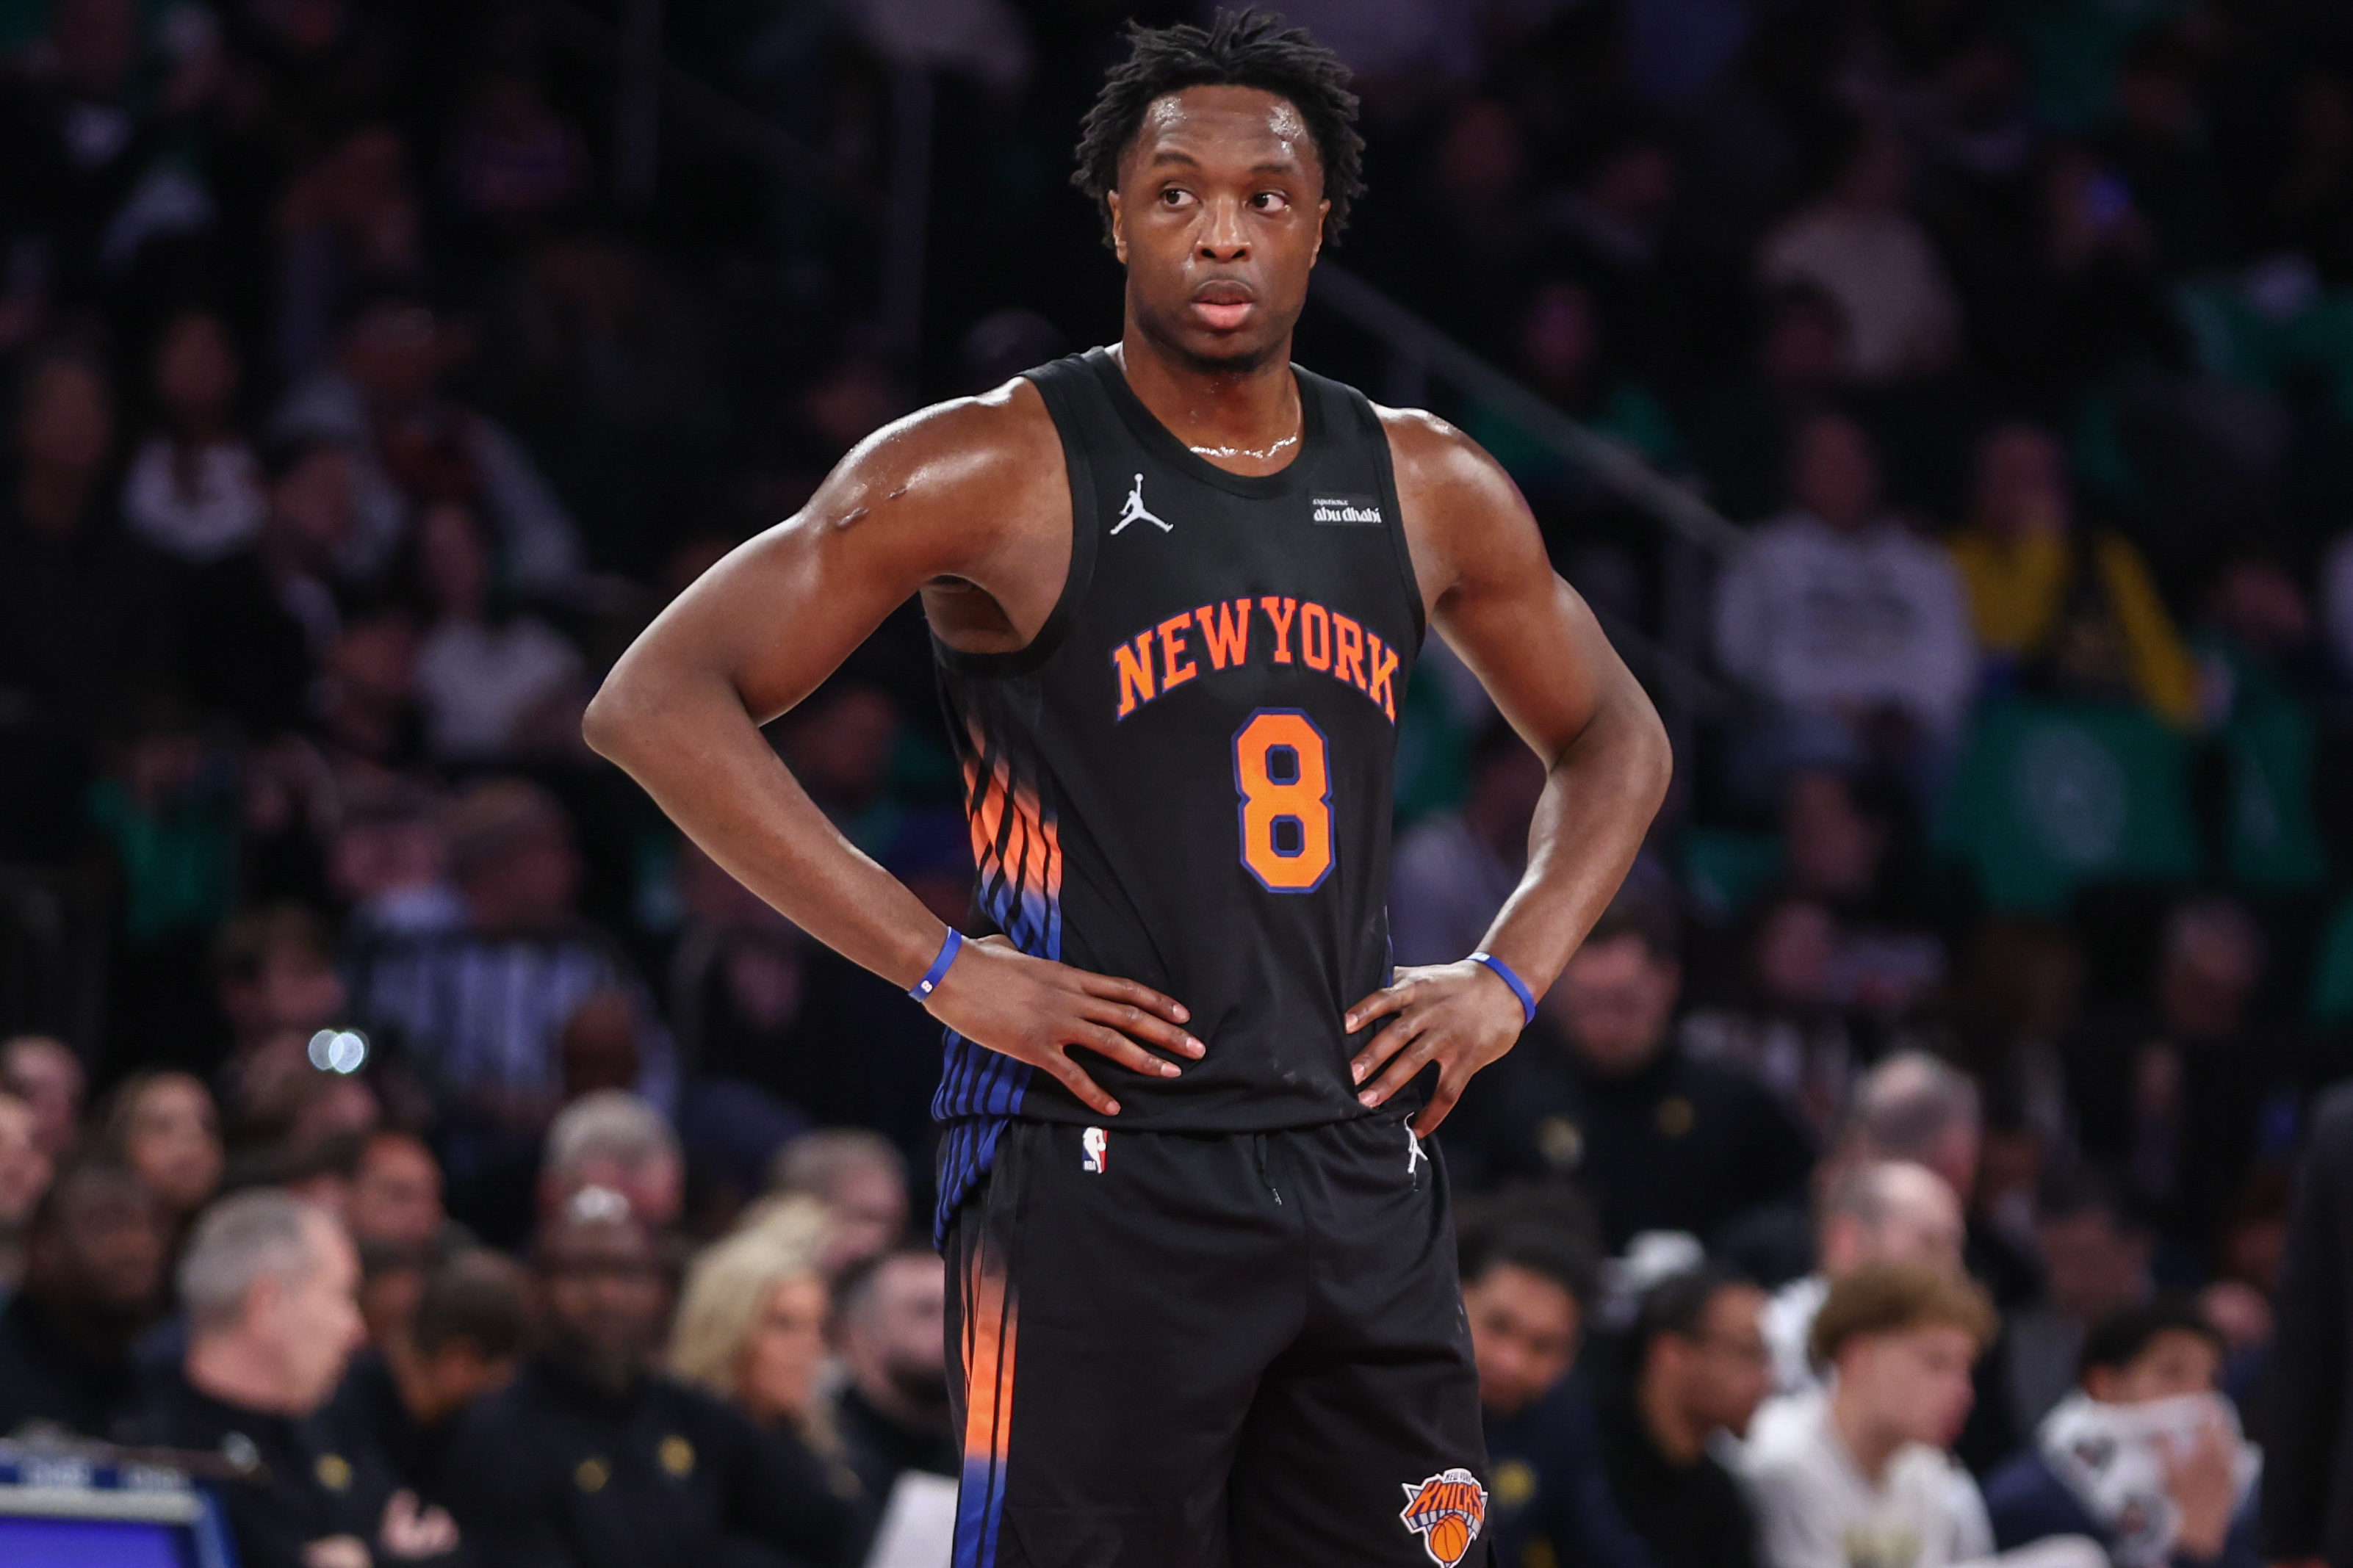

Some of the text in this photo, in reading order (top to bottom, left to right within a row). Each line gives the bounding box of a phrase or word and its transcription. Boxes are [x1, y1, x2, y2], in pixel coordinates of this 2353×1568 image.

[1314, 507, 1382, 523] abu dhabi
[1111, 596, 1400, 726] NEW YORK
[1231, 707, 1336, 894] 8
[1084, 1160, 1096, 1171] NBA
[1444, 1472, 1458, 1482] NEW
[1405, 1481, 1484, 1524] KNICKS
